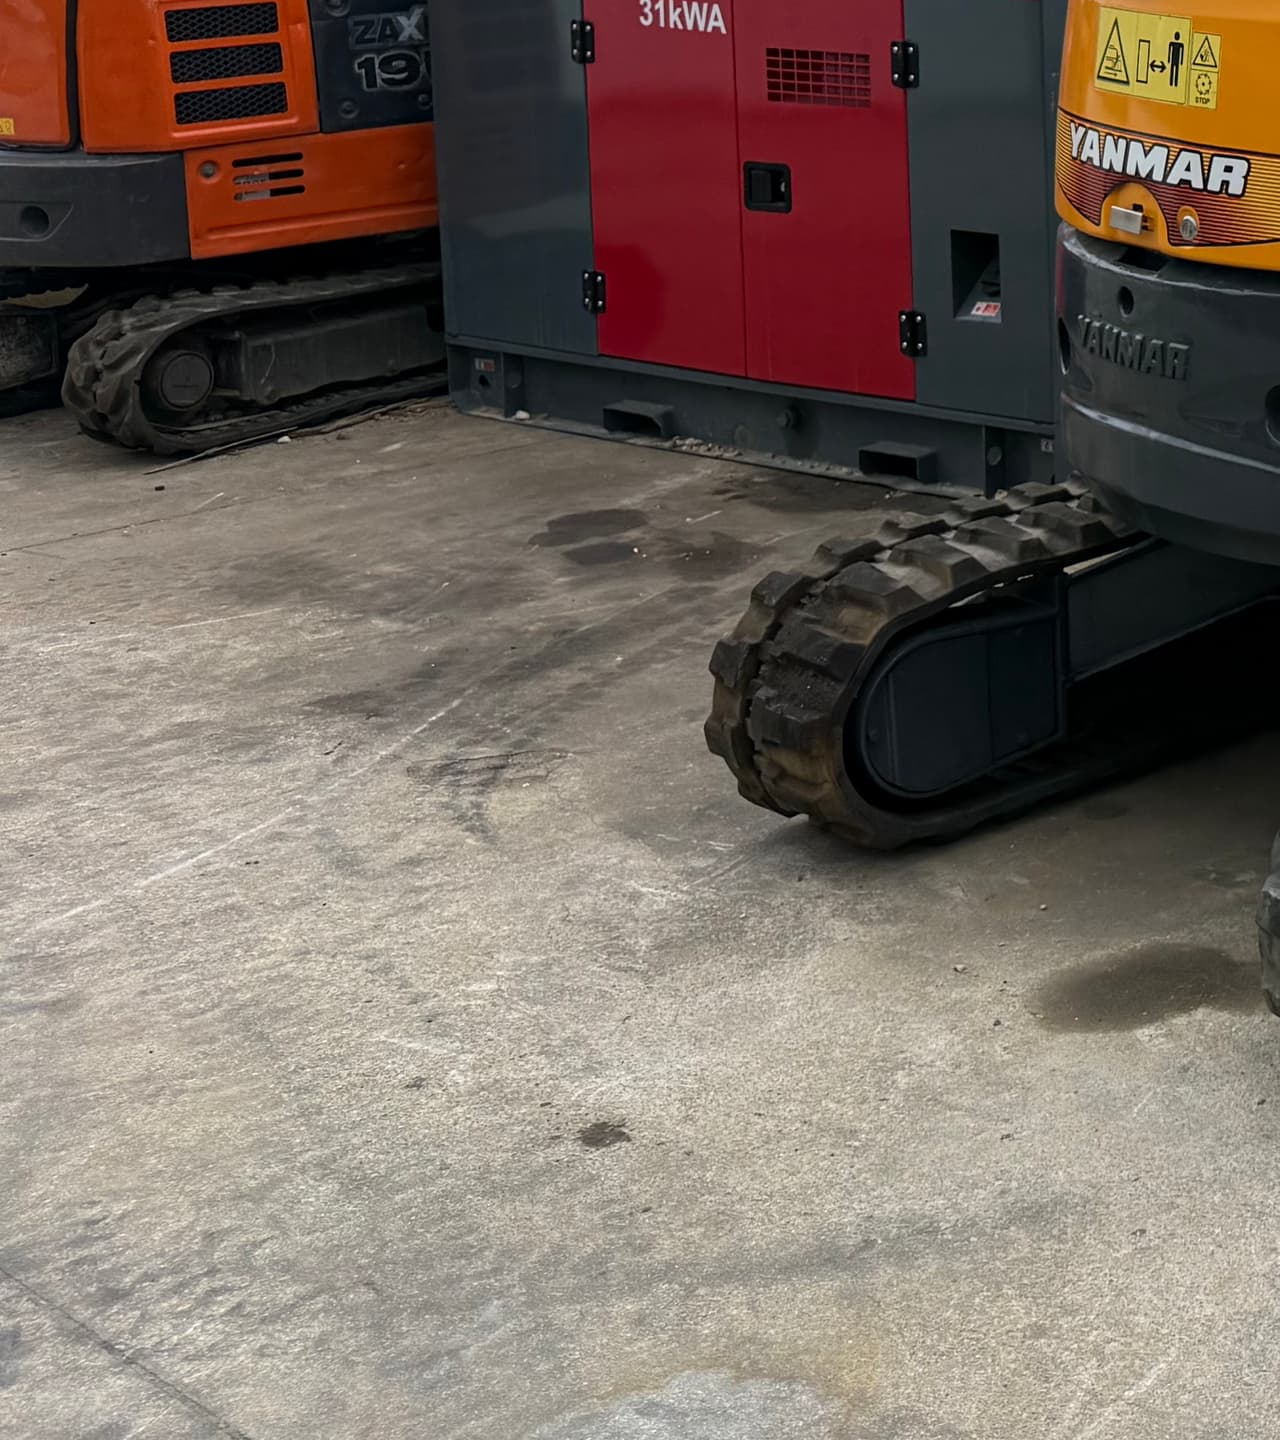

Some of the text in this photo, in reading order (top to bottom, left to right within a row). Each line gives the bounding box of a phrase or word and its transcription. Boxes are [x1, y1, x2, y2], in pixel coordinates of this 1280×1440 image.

[1195, 96, 1210, 105] STOP
[1070, 122, 1250, 196] YANMAR
[1077, 314, 1191, 381] YANMAR
